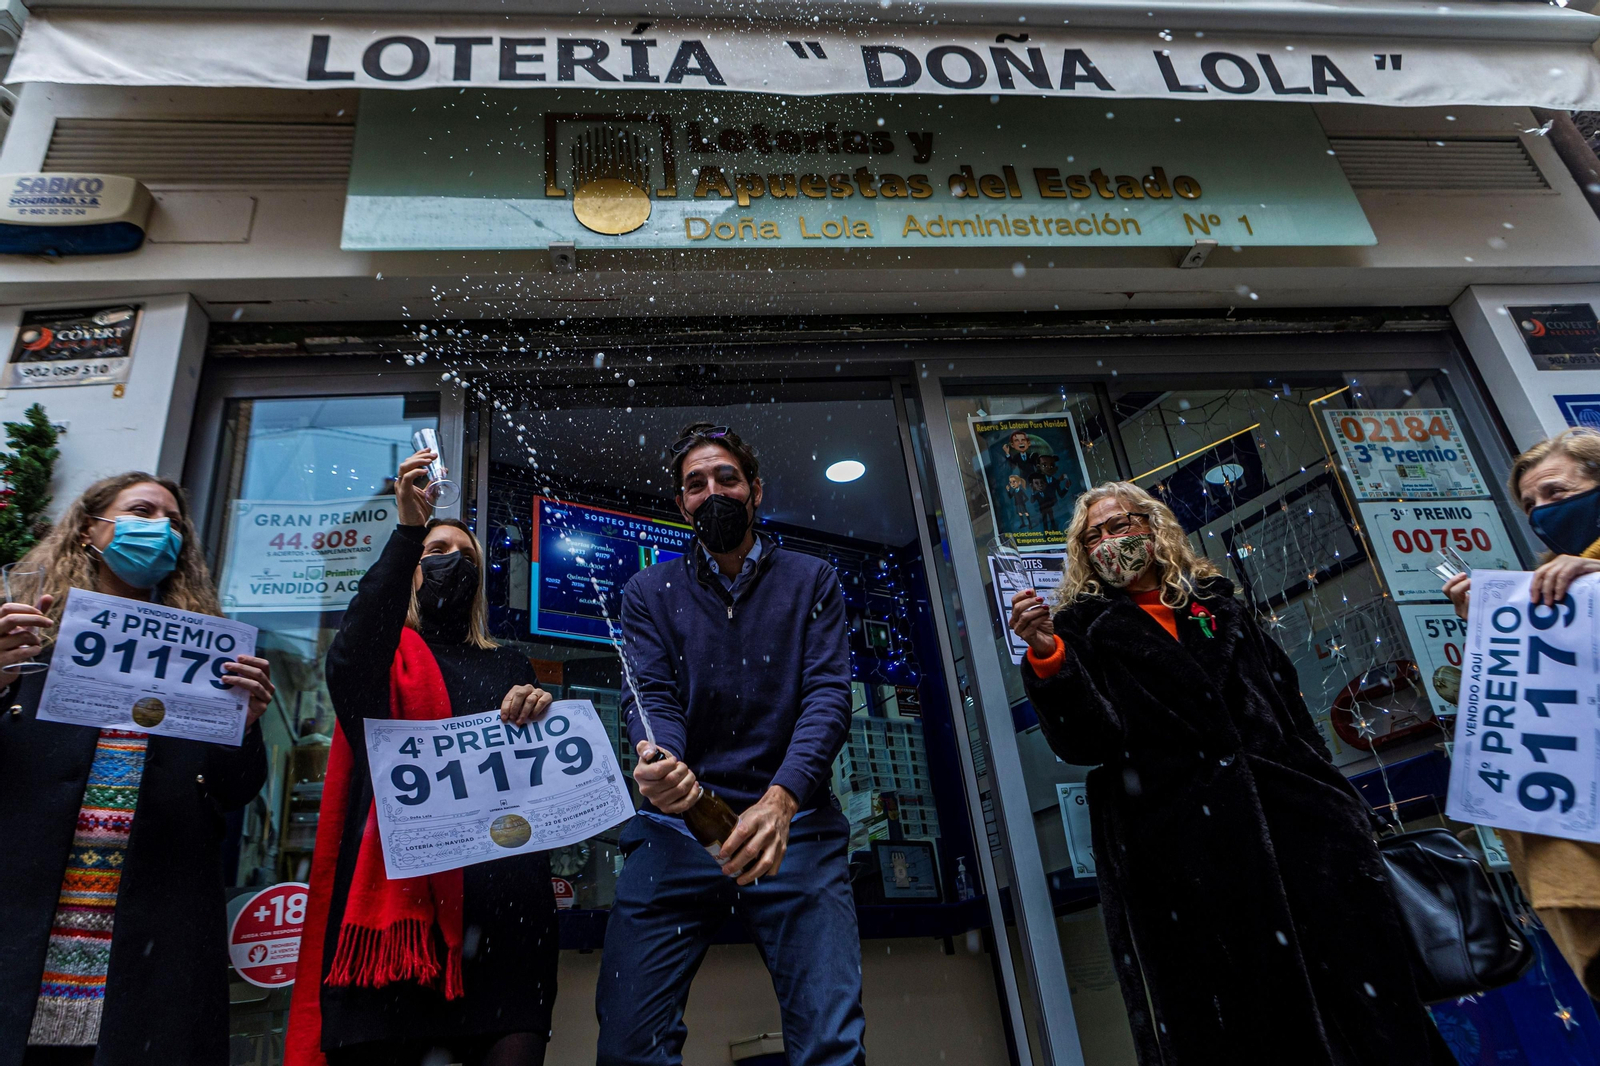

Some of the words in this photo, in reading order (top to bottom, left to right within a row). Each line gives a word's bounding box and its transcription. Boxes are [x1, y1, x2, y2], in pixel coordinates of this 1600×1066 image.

[306, 23, 727, 87] LOTERÍA
[861, 33, 1114, 92] DOÑA
[1153, 51, 1366, 97] LOLA
[907, 131, 934, 163] y
[14, 177, 104, 194] SABICO
[694, 165, 933, 206] Apuestas
[948, 165, 1022, 199] del
[1033, 166, 1202, 199] Estado
[685, 217, 781, 240] Doña
[799, 215, 874, 239] Lola
[902, 212, 1141, 238] Administración
[1183, 212, 1221, 235] Nº
[1238, 214, 1254, 235] 1
[1546, 321, 1592, 330] COVERT
[1570, 355, 1588, 363] 099
[23, 367, 50, 378] 902
[53, 365, 79, 377] 099
[82, 363, 109, 375] 510
[976, 423, 999, 432] Reserve
[1000, 422, 1008, 431] Su
[1029, 420, 1043, 429] Para
[1043, 419, 1068, 428] Navidad
[1340, 416, 1451, 443] 02184
[1382, 446, 1458, 463] Premio
[254, 513, 312, 527] GRAN
[319, 508, 388, 526] PREMIO
[1413, 506, 1473, 521] PREMIO
[584, 512, 625, 527] SORTEO
[628, 521, 697, 540] EXTRAORDIN
[268, 529, 358, 551] 44.808
[362, 535, 372, 545] €
[623, 529, 636, 538] DE
[639, 531, 684, 547] AVIDAD
[1391, 527, 1493, 555] 00750
[310, 546, 372, 557] COMPLEMENTARIO
[293, 571, 304, 579] La
[325, 567, 367, 578] Primitiva
[250, 581, 329, 595] VENDIDO
[334, 580, 359, 593] AQ
[136, 606, 179, 621] VENDIDO
[180, 615, 204, 626] AQUÍ
[121, 613, 236, 653] PREMIO
[71, 630, 239, 691] 91179
[1472, 652, 1484, 682] AQUÍ
[1480, 605, 1522, 755] PREMIO
[1465, 684, 1481, 737] VENDIDO
[1517, 593, 1578, 813] 91179
[190, 715, 217, 724] DICIEMBRE
[442, 717, 493, 732] VENDIDO
[432, 715, 571, 757] PREMIO
[390, 736, 594, 806] 91179
[575, 779, 593, 788] TOLEDO
[554, 818, 562, 826] DE
[563, 807, 596, 823] DICIEMBRE
[596, 801, 610, 809] 2021
[405, 843, 434, 851] LOTERÍA
[444, 837, 475, 846] NAVIDAD
[253, 893, 308, 926] +18
